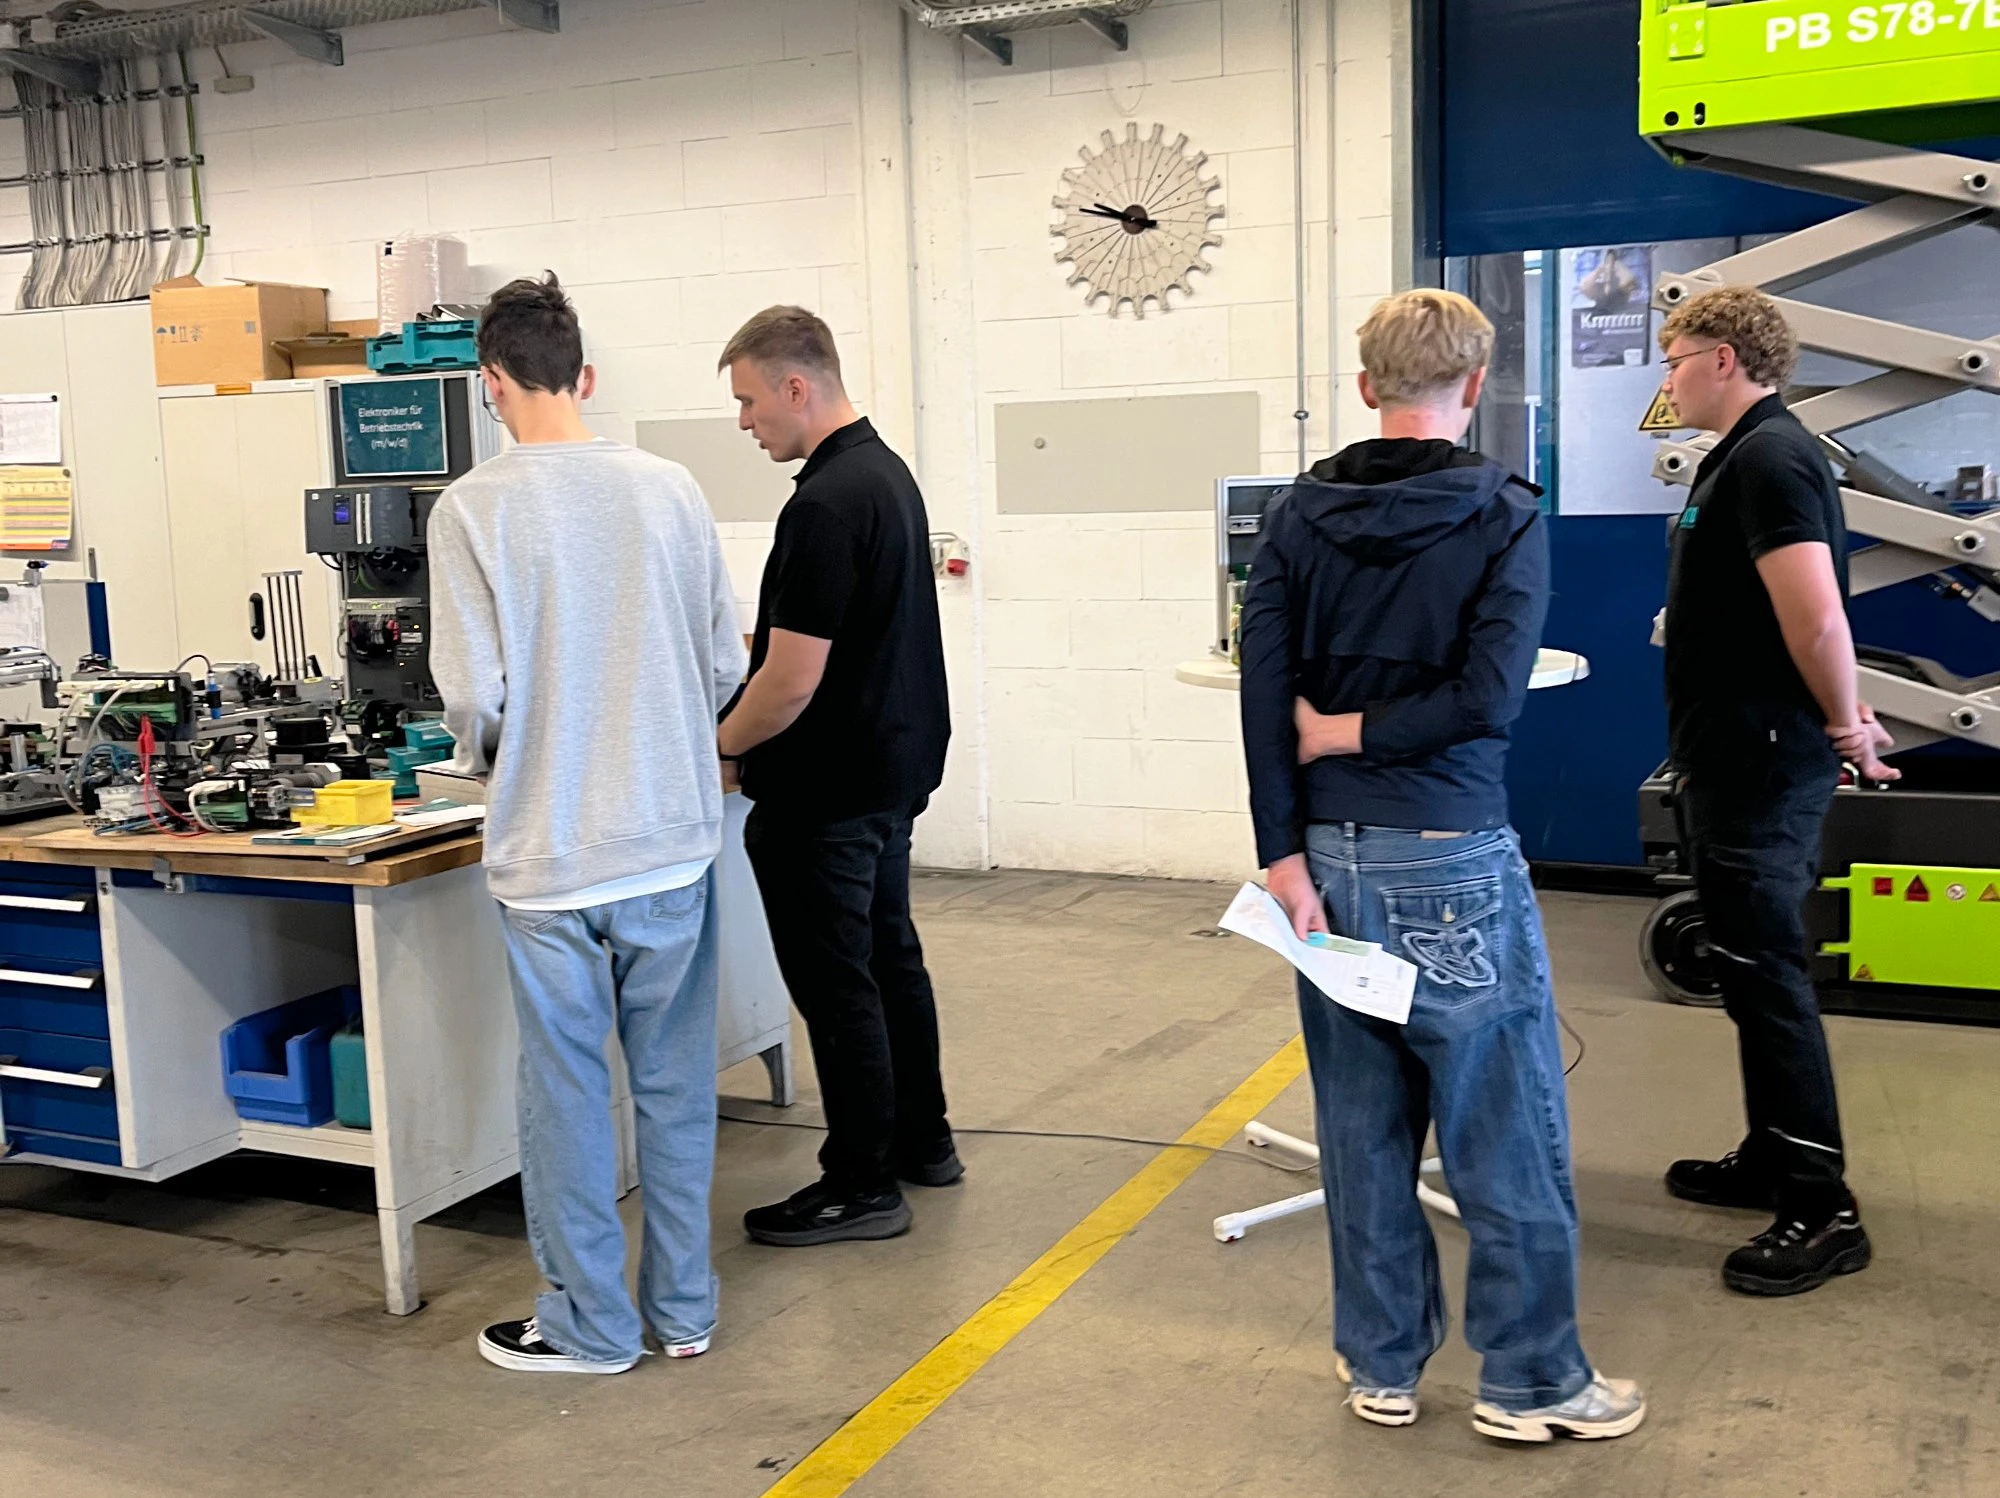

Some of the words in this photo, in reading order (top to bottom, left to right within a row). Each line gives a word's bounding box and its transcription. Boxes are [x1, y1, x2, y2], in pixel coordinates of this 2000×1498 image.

[1766, 12, 1832, 53] PB
[358, 406, 408, 417] Elektroniker
[409, 405, 423, 415] für
[359, 421, 423, 433] Betriebstechnik
[371, 438, 408, 449] (m/w/d)
